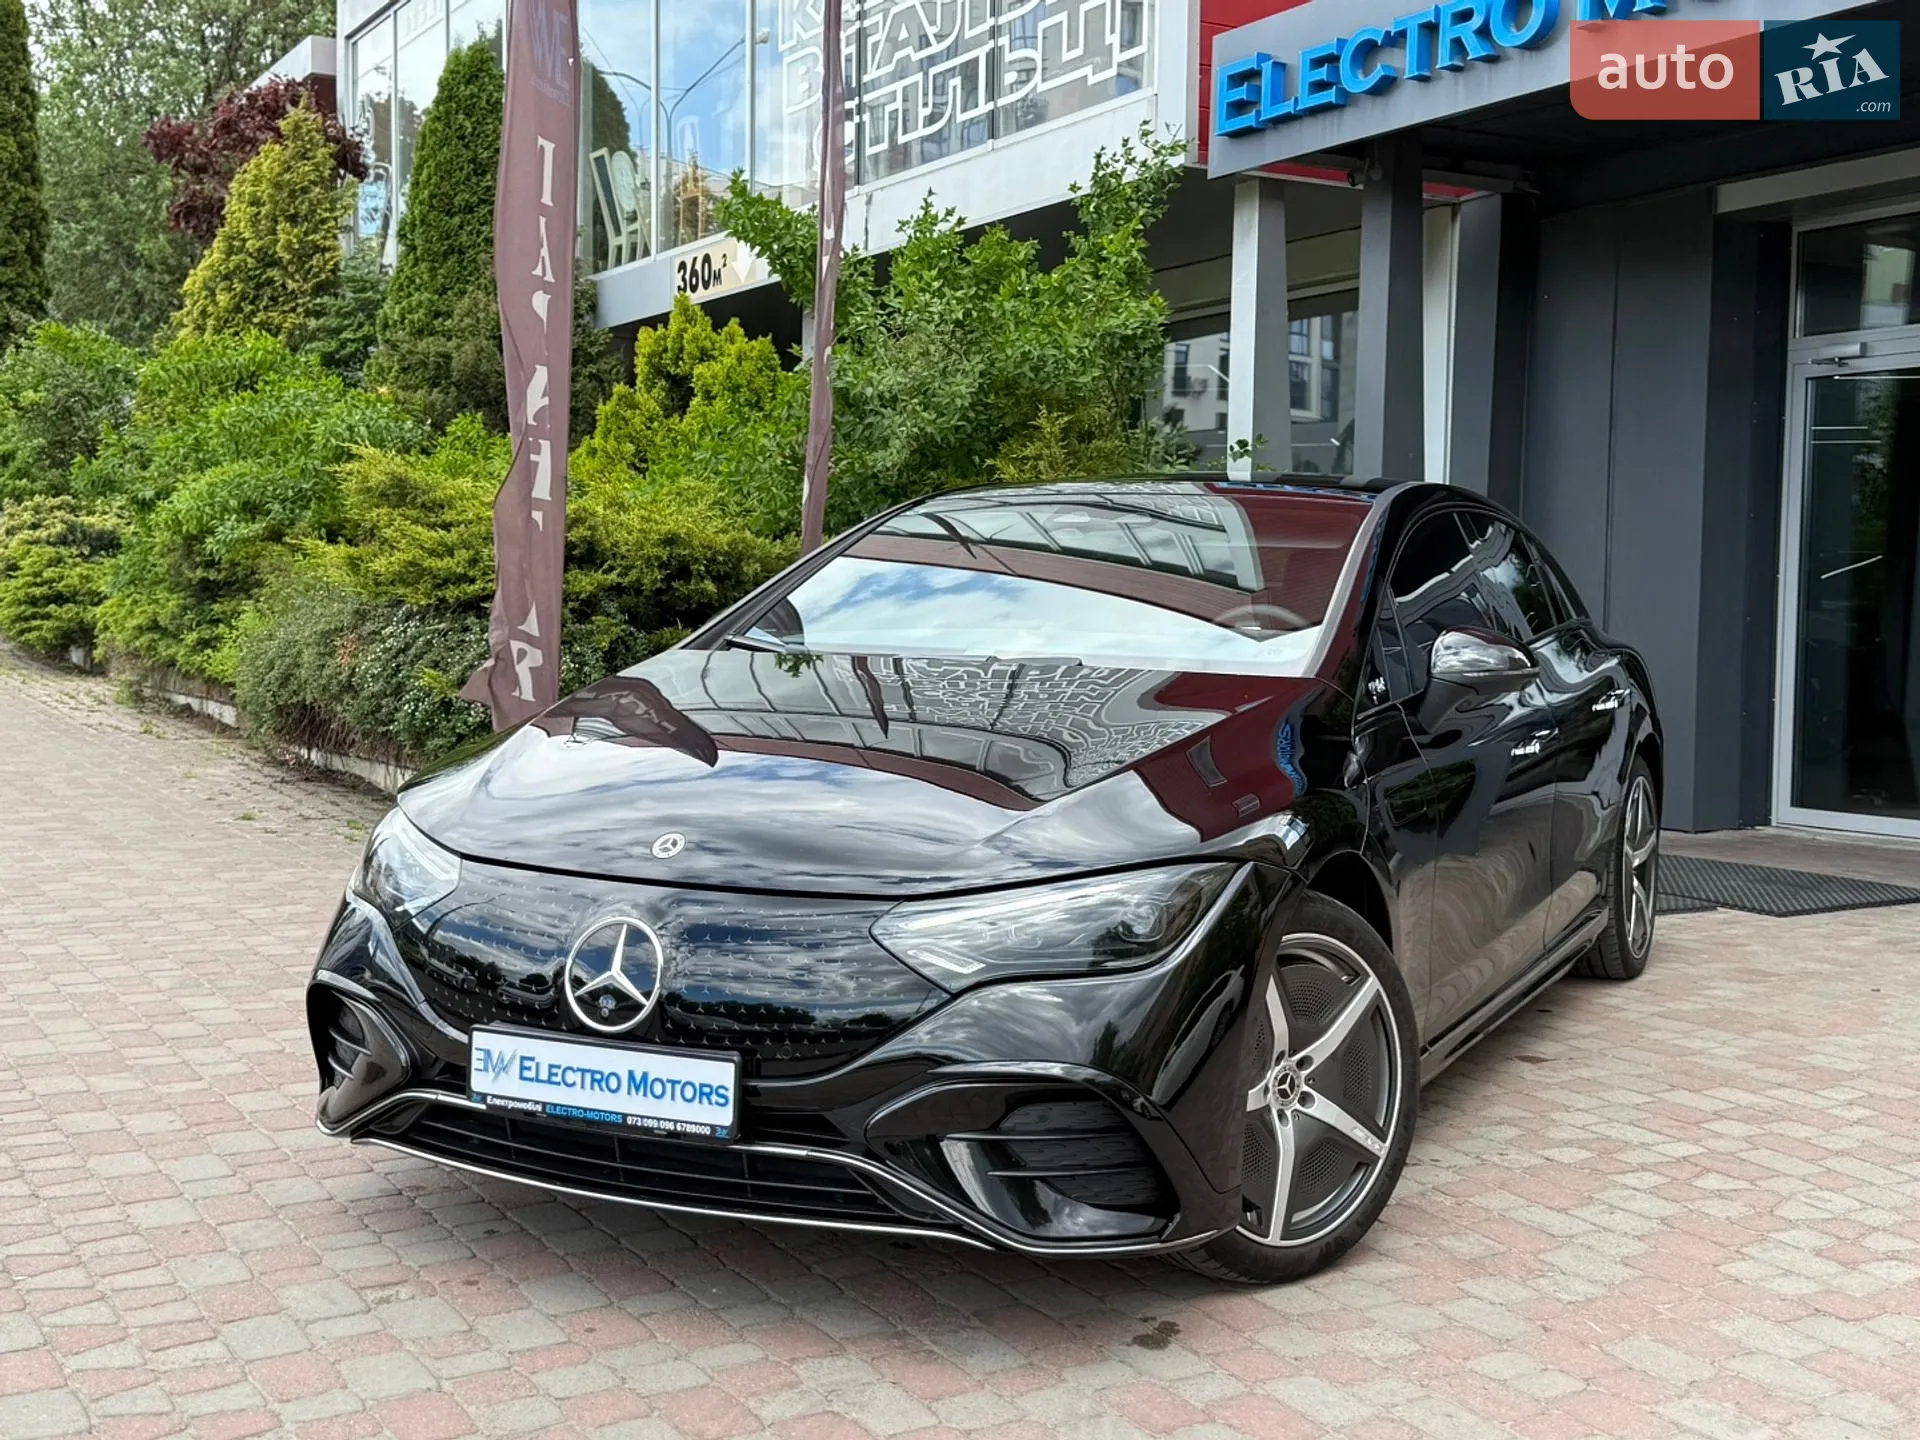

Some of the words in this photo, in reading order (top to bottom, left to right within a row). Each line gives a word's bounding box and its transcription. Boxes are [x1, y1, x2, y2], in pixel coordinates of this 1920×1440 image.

[1214, 0, 1562, 138] ELECTRO
[518, 1055, 622, 1094] ELECTRO
[626, 1069, 730, 1108] MOTORS
